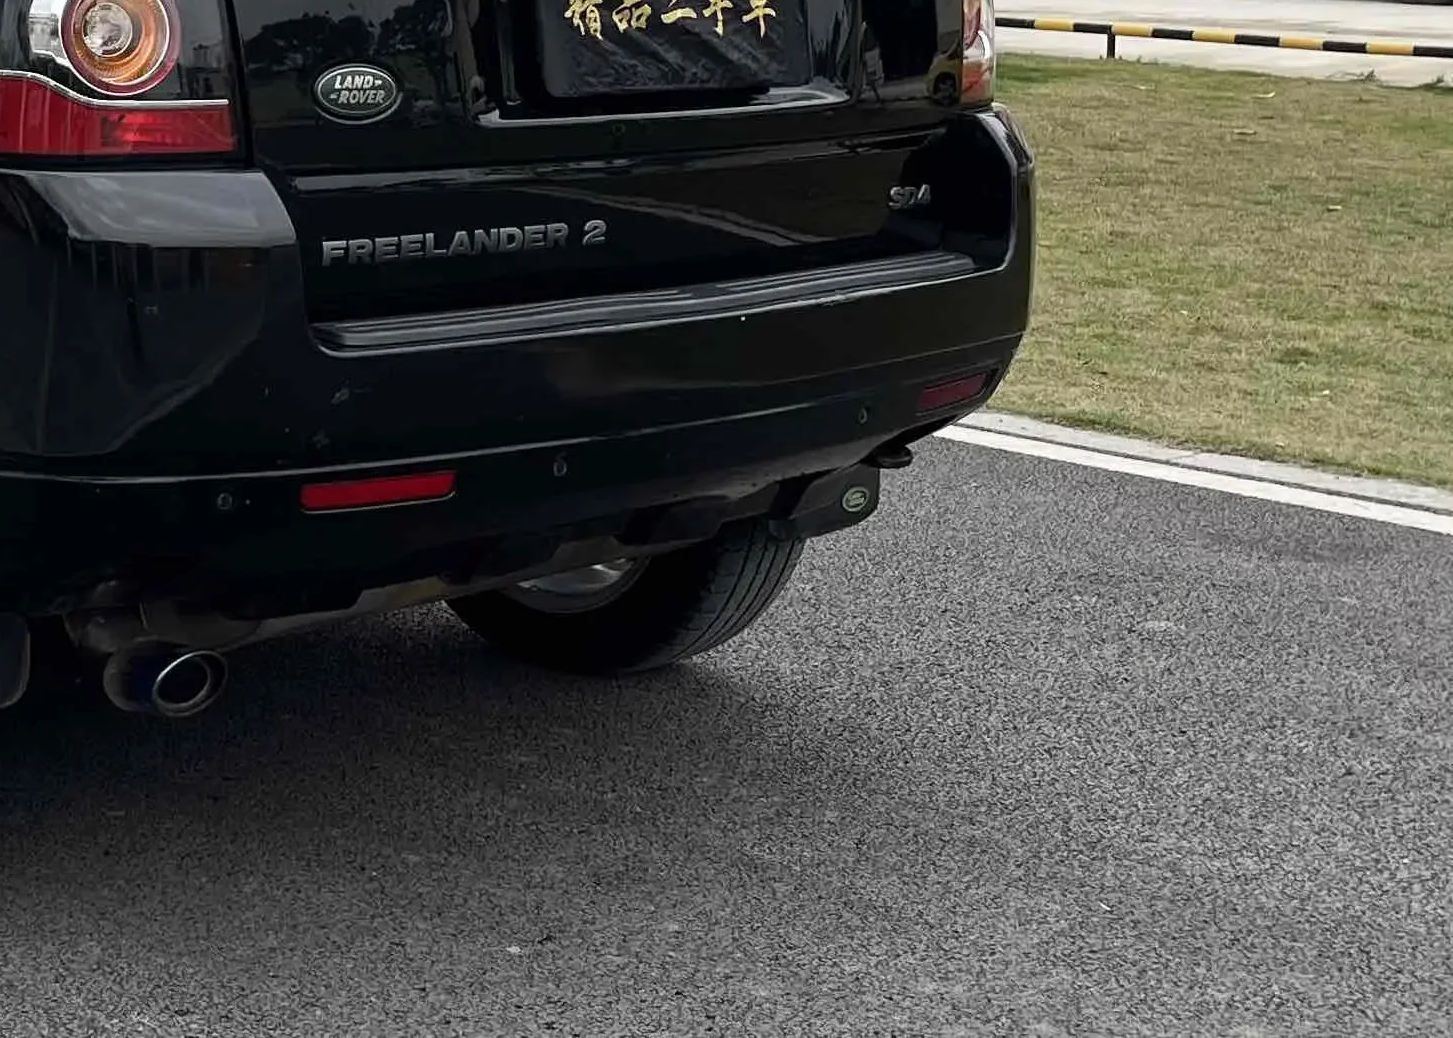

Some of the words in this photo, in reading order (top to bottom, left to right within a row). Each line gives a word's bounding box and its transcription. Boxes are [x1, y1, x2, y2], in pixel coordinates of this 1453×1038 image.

[334, 75, 374, 89] LAND
[338, 90, 385, 104] ROVER
[322, 222, 569, 266] FREELANDER
[582, 219, 607, 246] 2
